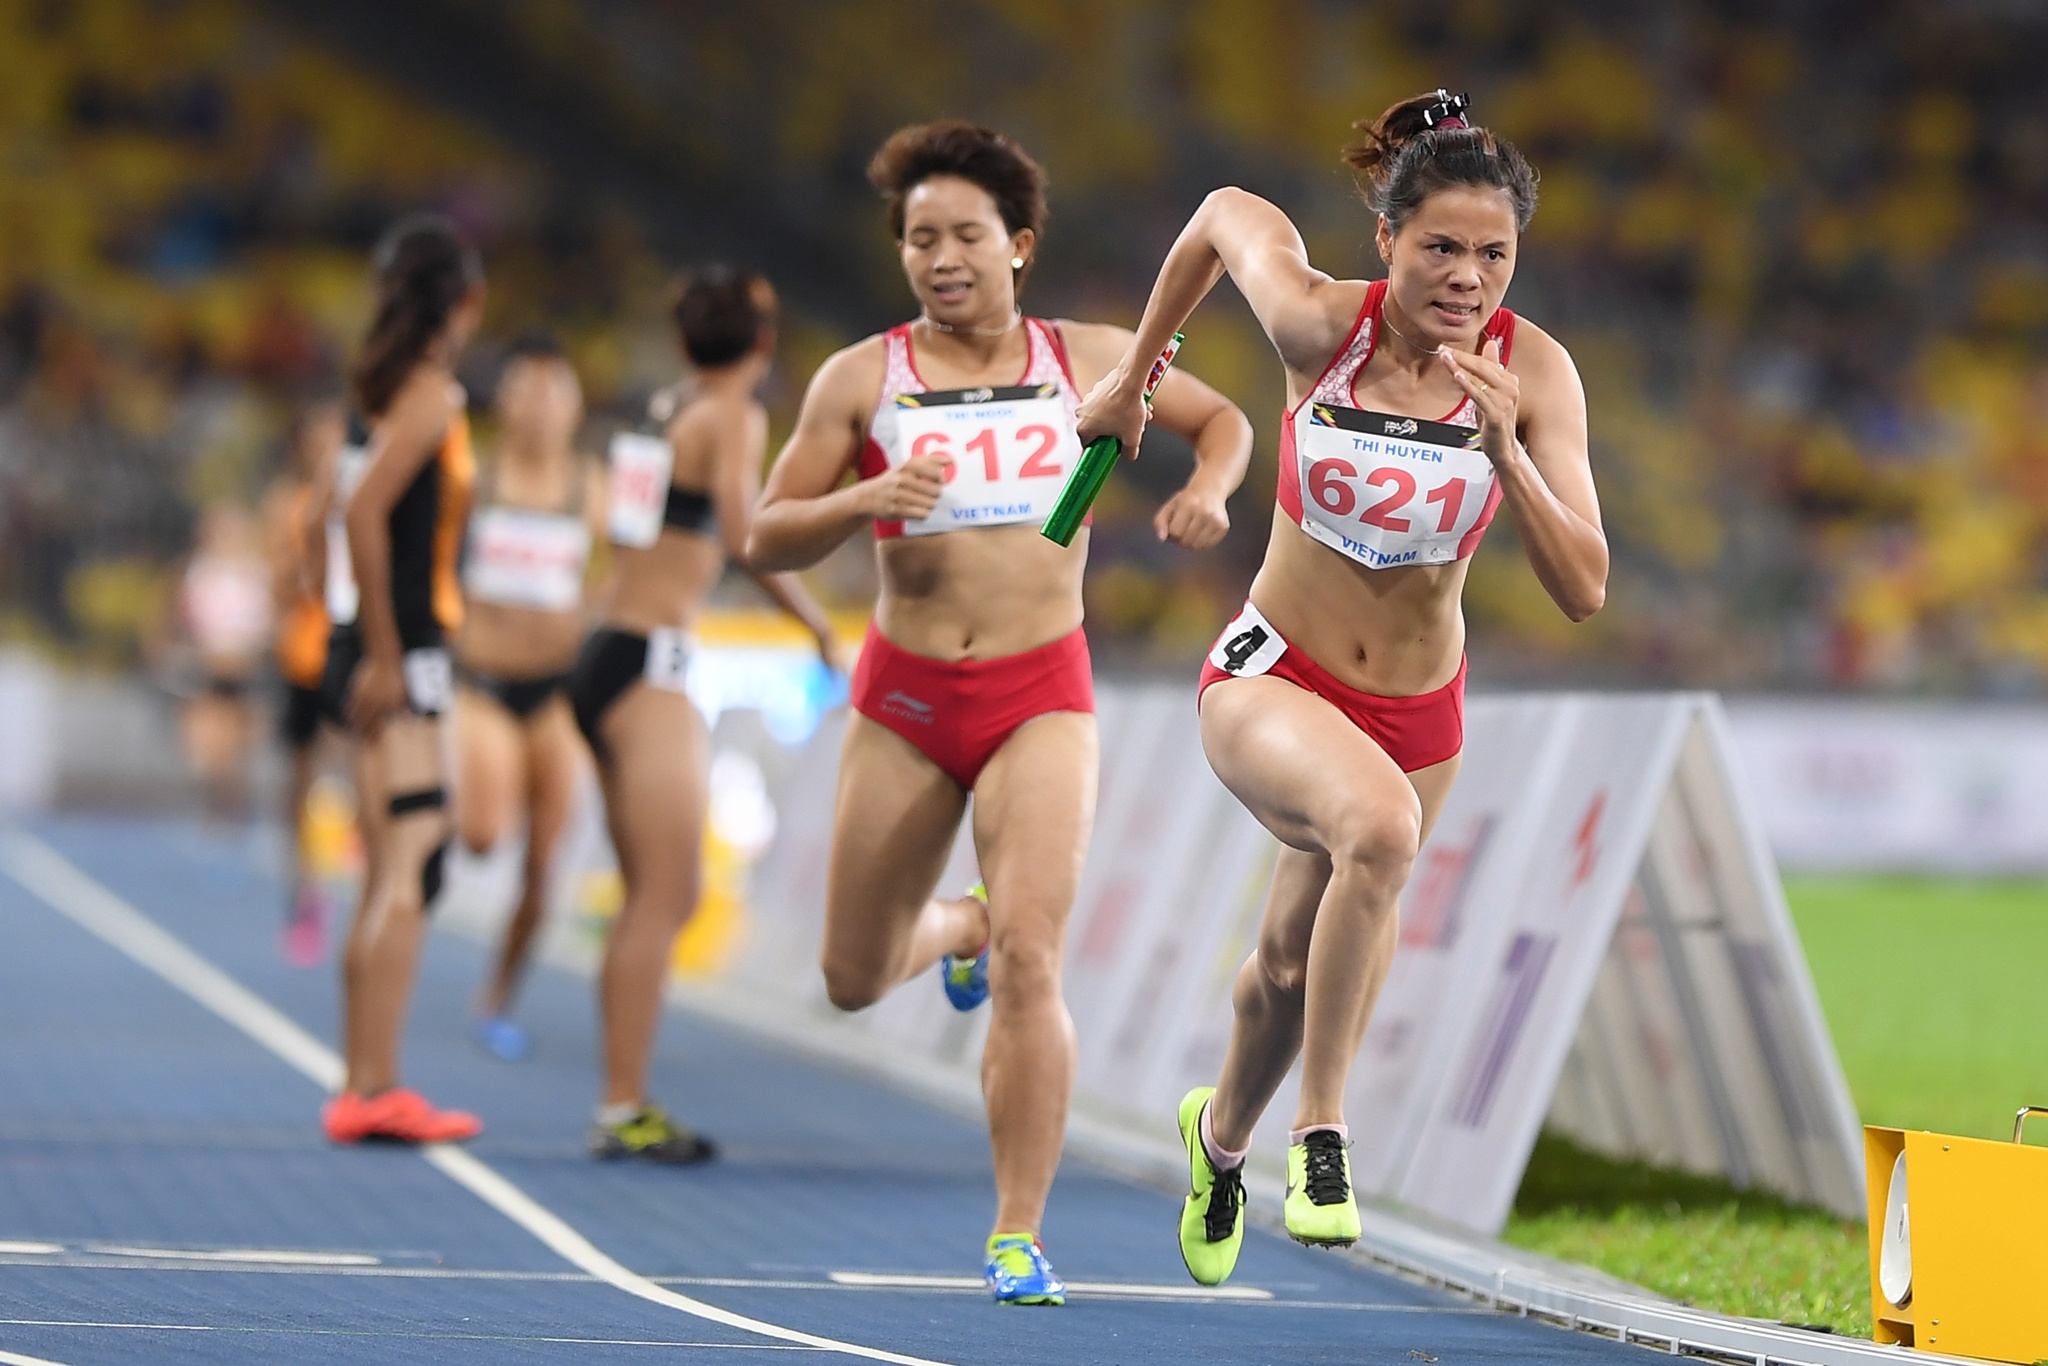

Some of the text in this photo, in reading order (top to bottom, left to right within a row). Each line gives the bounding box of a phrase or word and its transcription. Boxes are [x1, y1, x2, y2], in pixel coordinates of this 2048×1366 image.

[1353, 438, 1443, 463] THI HUYEN
[1308, 457, 1467, 533] 621
[952, 503, 1032, 520] VIETNAM
[1341, 535, 1417, 565] VIETNAM
[1223, 624, 1269, 673] 4
